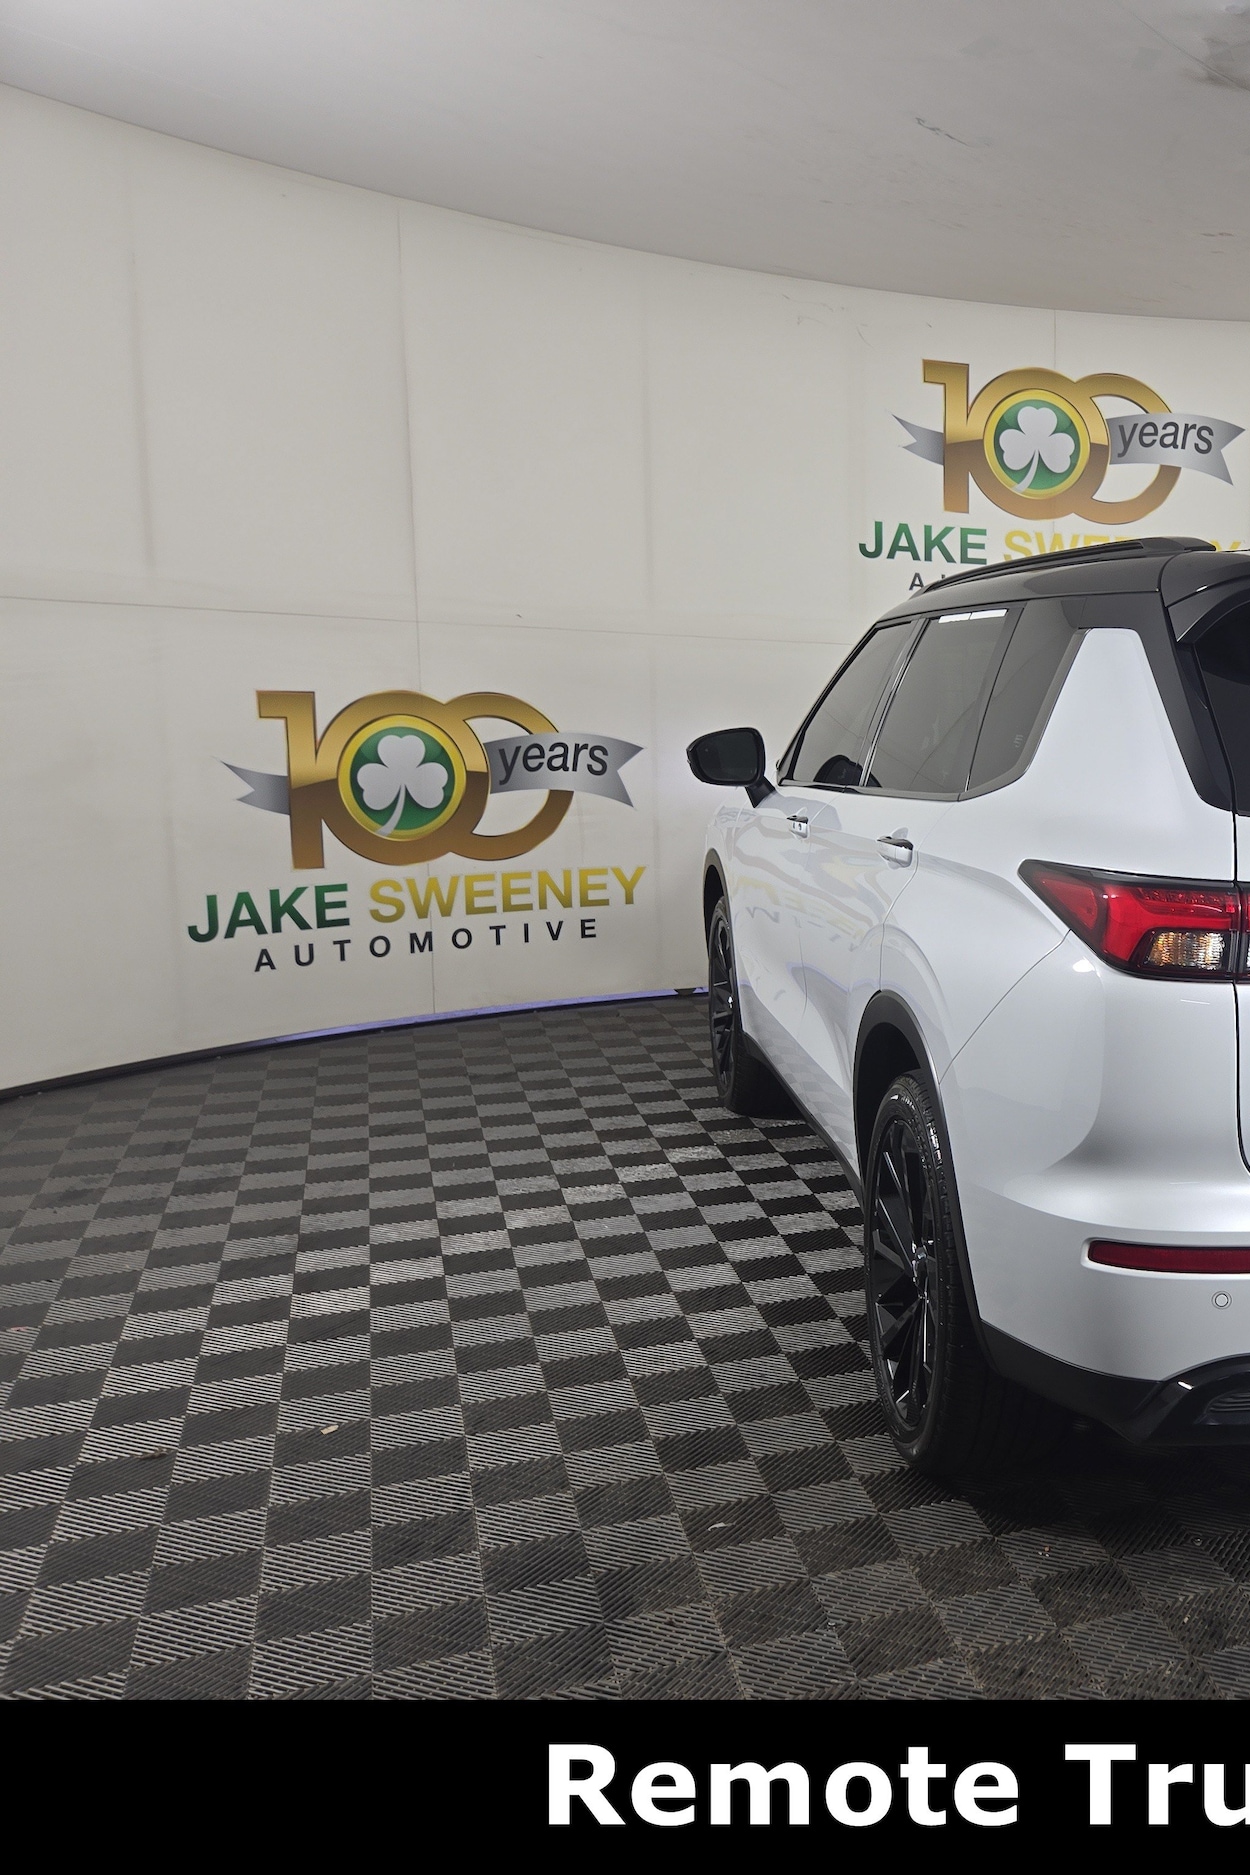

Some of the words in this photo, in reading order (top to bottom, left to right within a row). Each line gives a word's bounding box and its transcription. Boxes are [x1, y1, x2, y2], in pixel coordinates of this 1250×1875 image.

[1117, 421, 1214, 458] years
[858, 521, 987, 565] JAKE
[499, 741, 609, 785] years
[188, 883, 350, 943] JAKE
[369, 866, 647, 923] SWEENEY
[254, 919, 598, 972] AUTOMOTIVE
